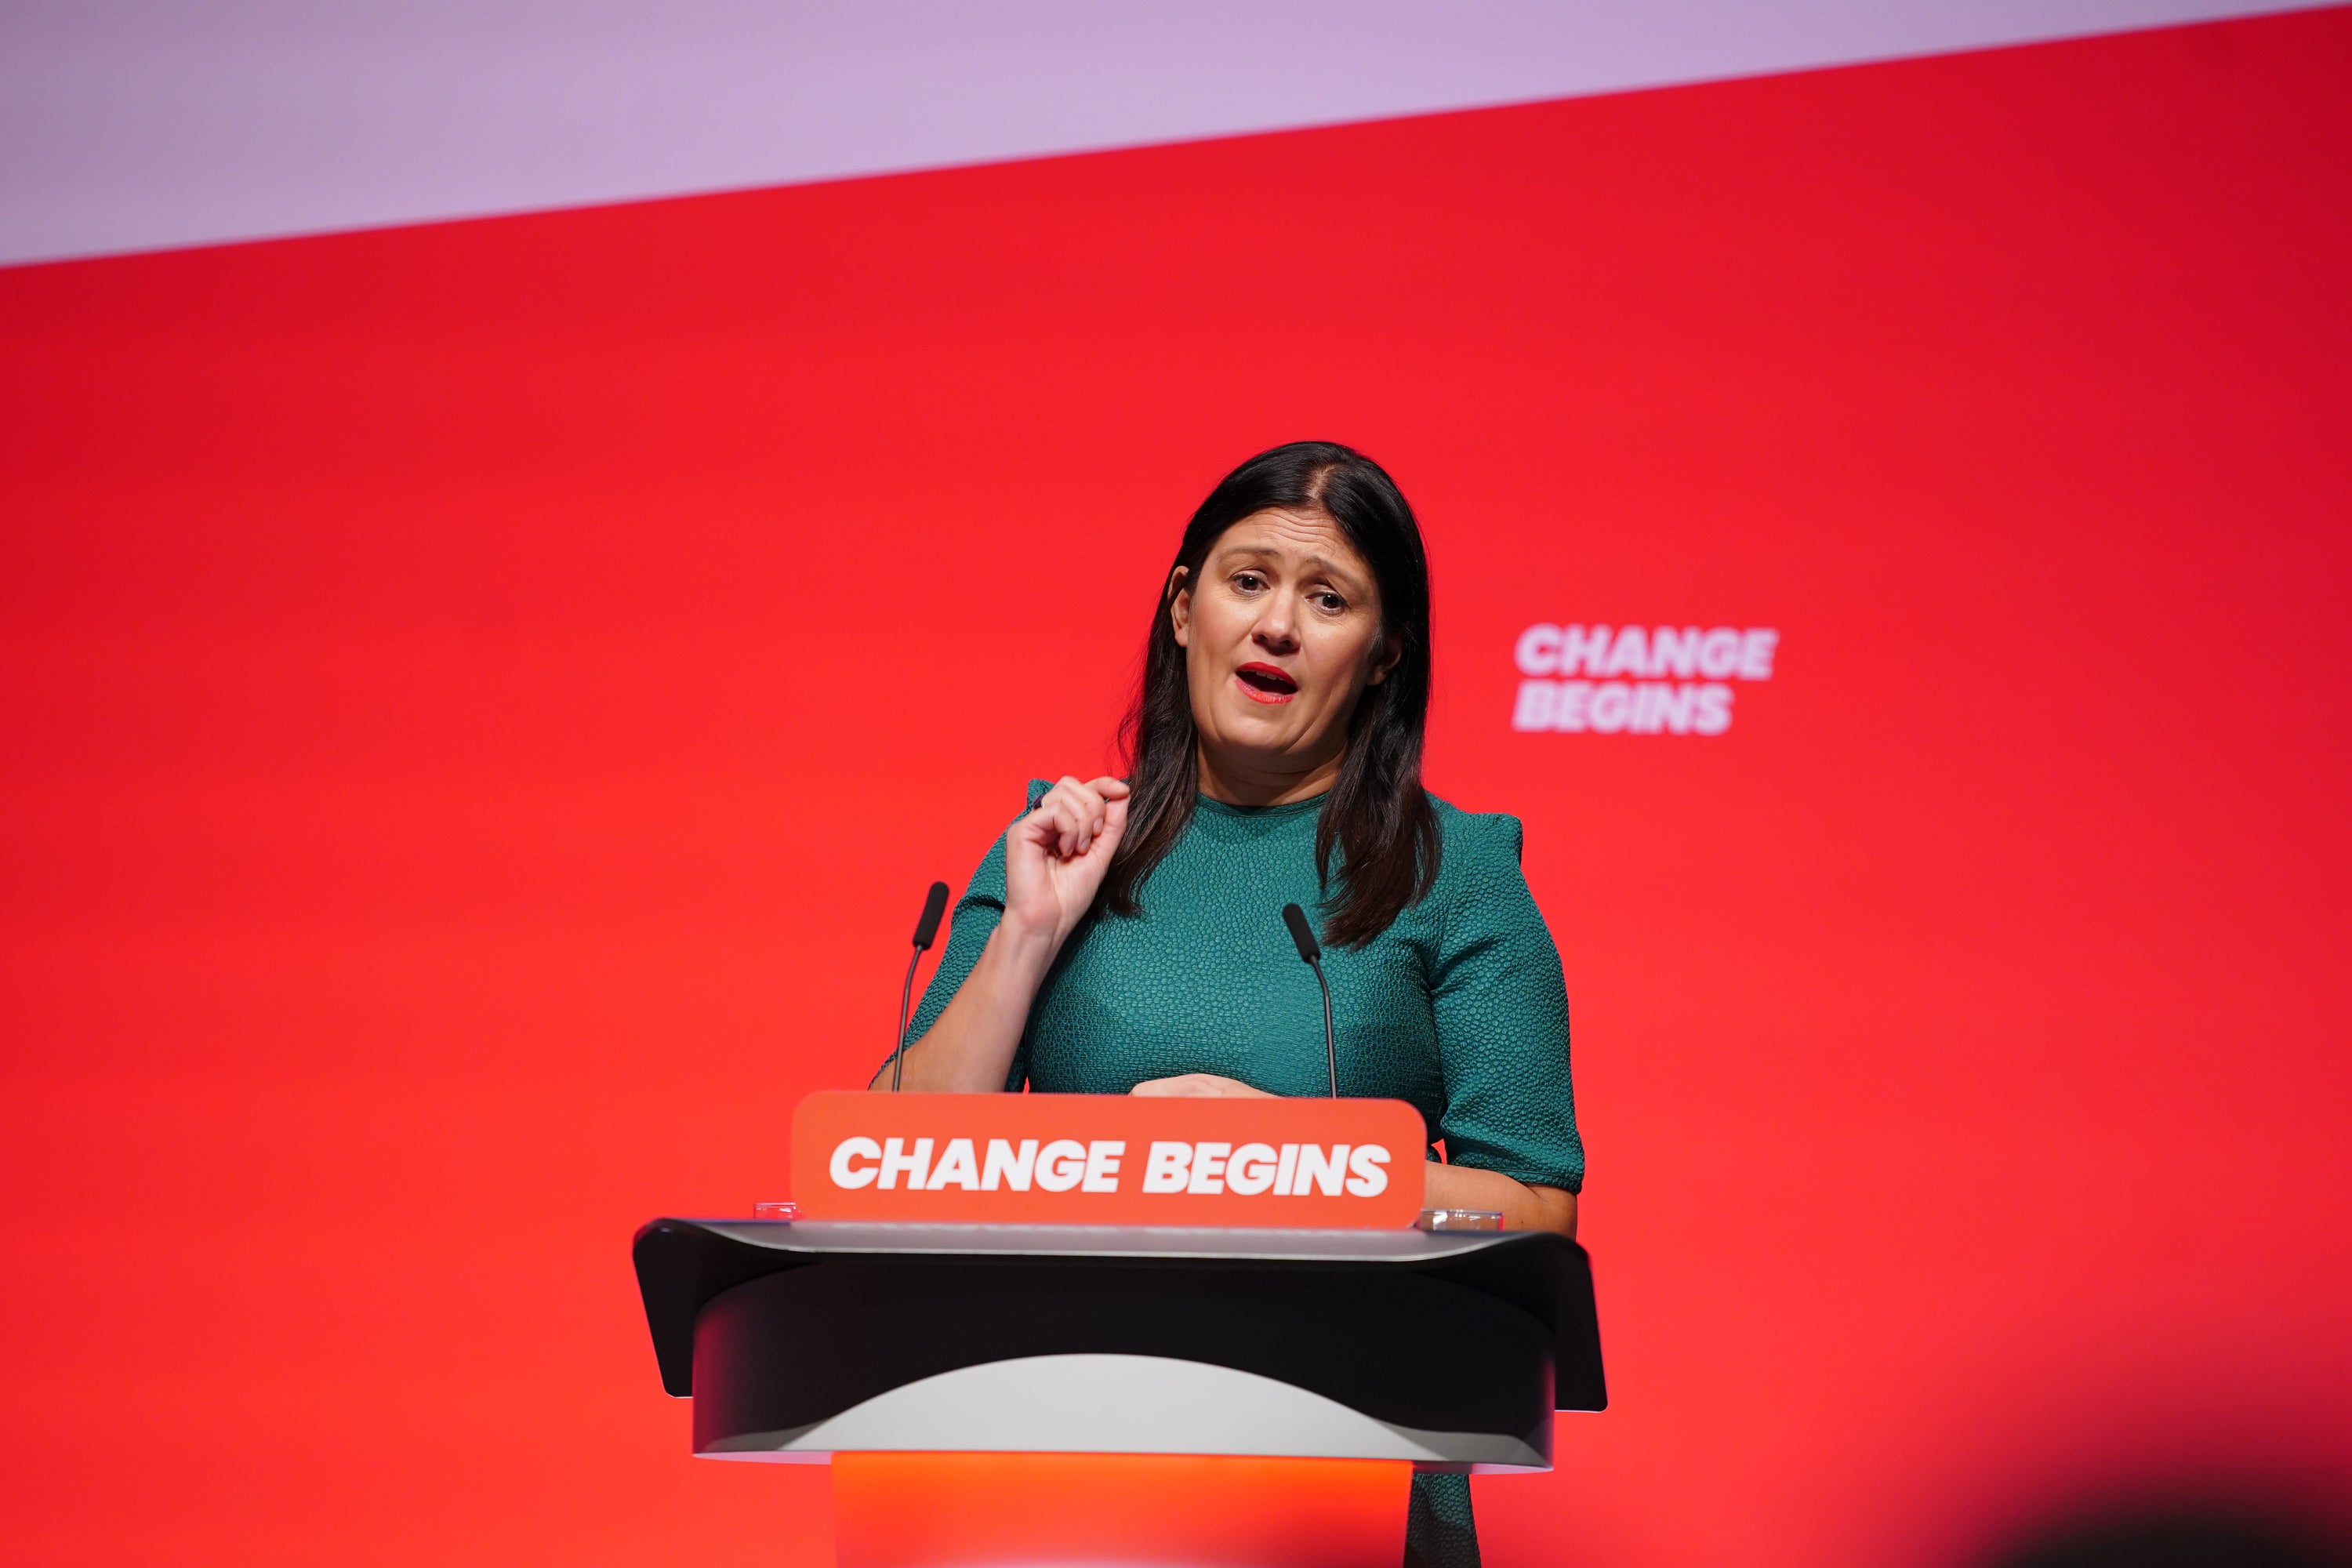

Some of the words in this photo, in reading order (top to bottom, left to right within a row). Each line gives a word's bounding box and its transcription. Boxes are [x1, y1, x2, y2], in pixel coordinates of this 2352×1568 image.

[1515, 624, 1779, 680] CHANGE
[1512, 680, 1734, 735] BEGINS
[829, 1136, 1126, 1193] CHANGE
[1142, 1141, 1392, 1198] BEGINS
